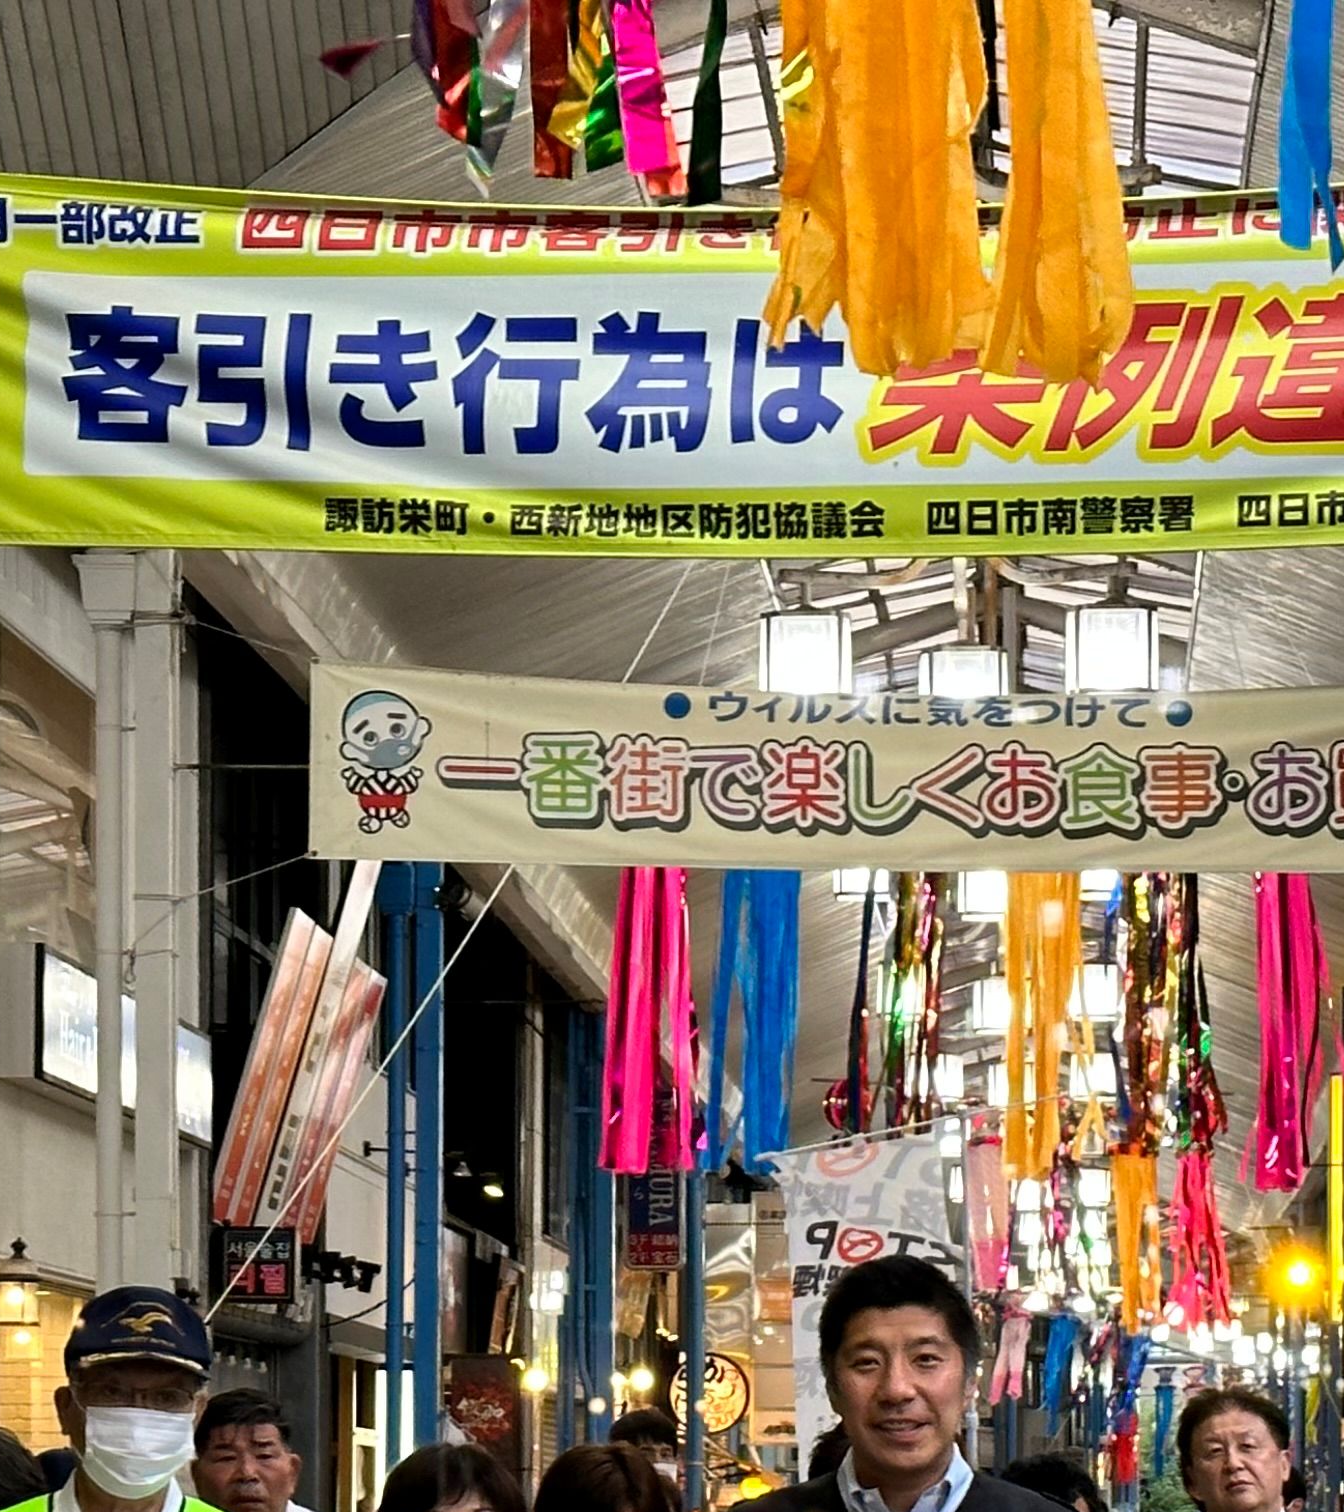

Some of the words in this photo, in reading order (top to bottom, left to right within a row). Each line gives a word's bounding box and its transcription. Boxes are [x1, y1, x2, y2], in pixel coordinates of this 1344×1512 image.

[927, 490, 1195, 537] 四日市南警察署
